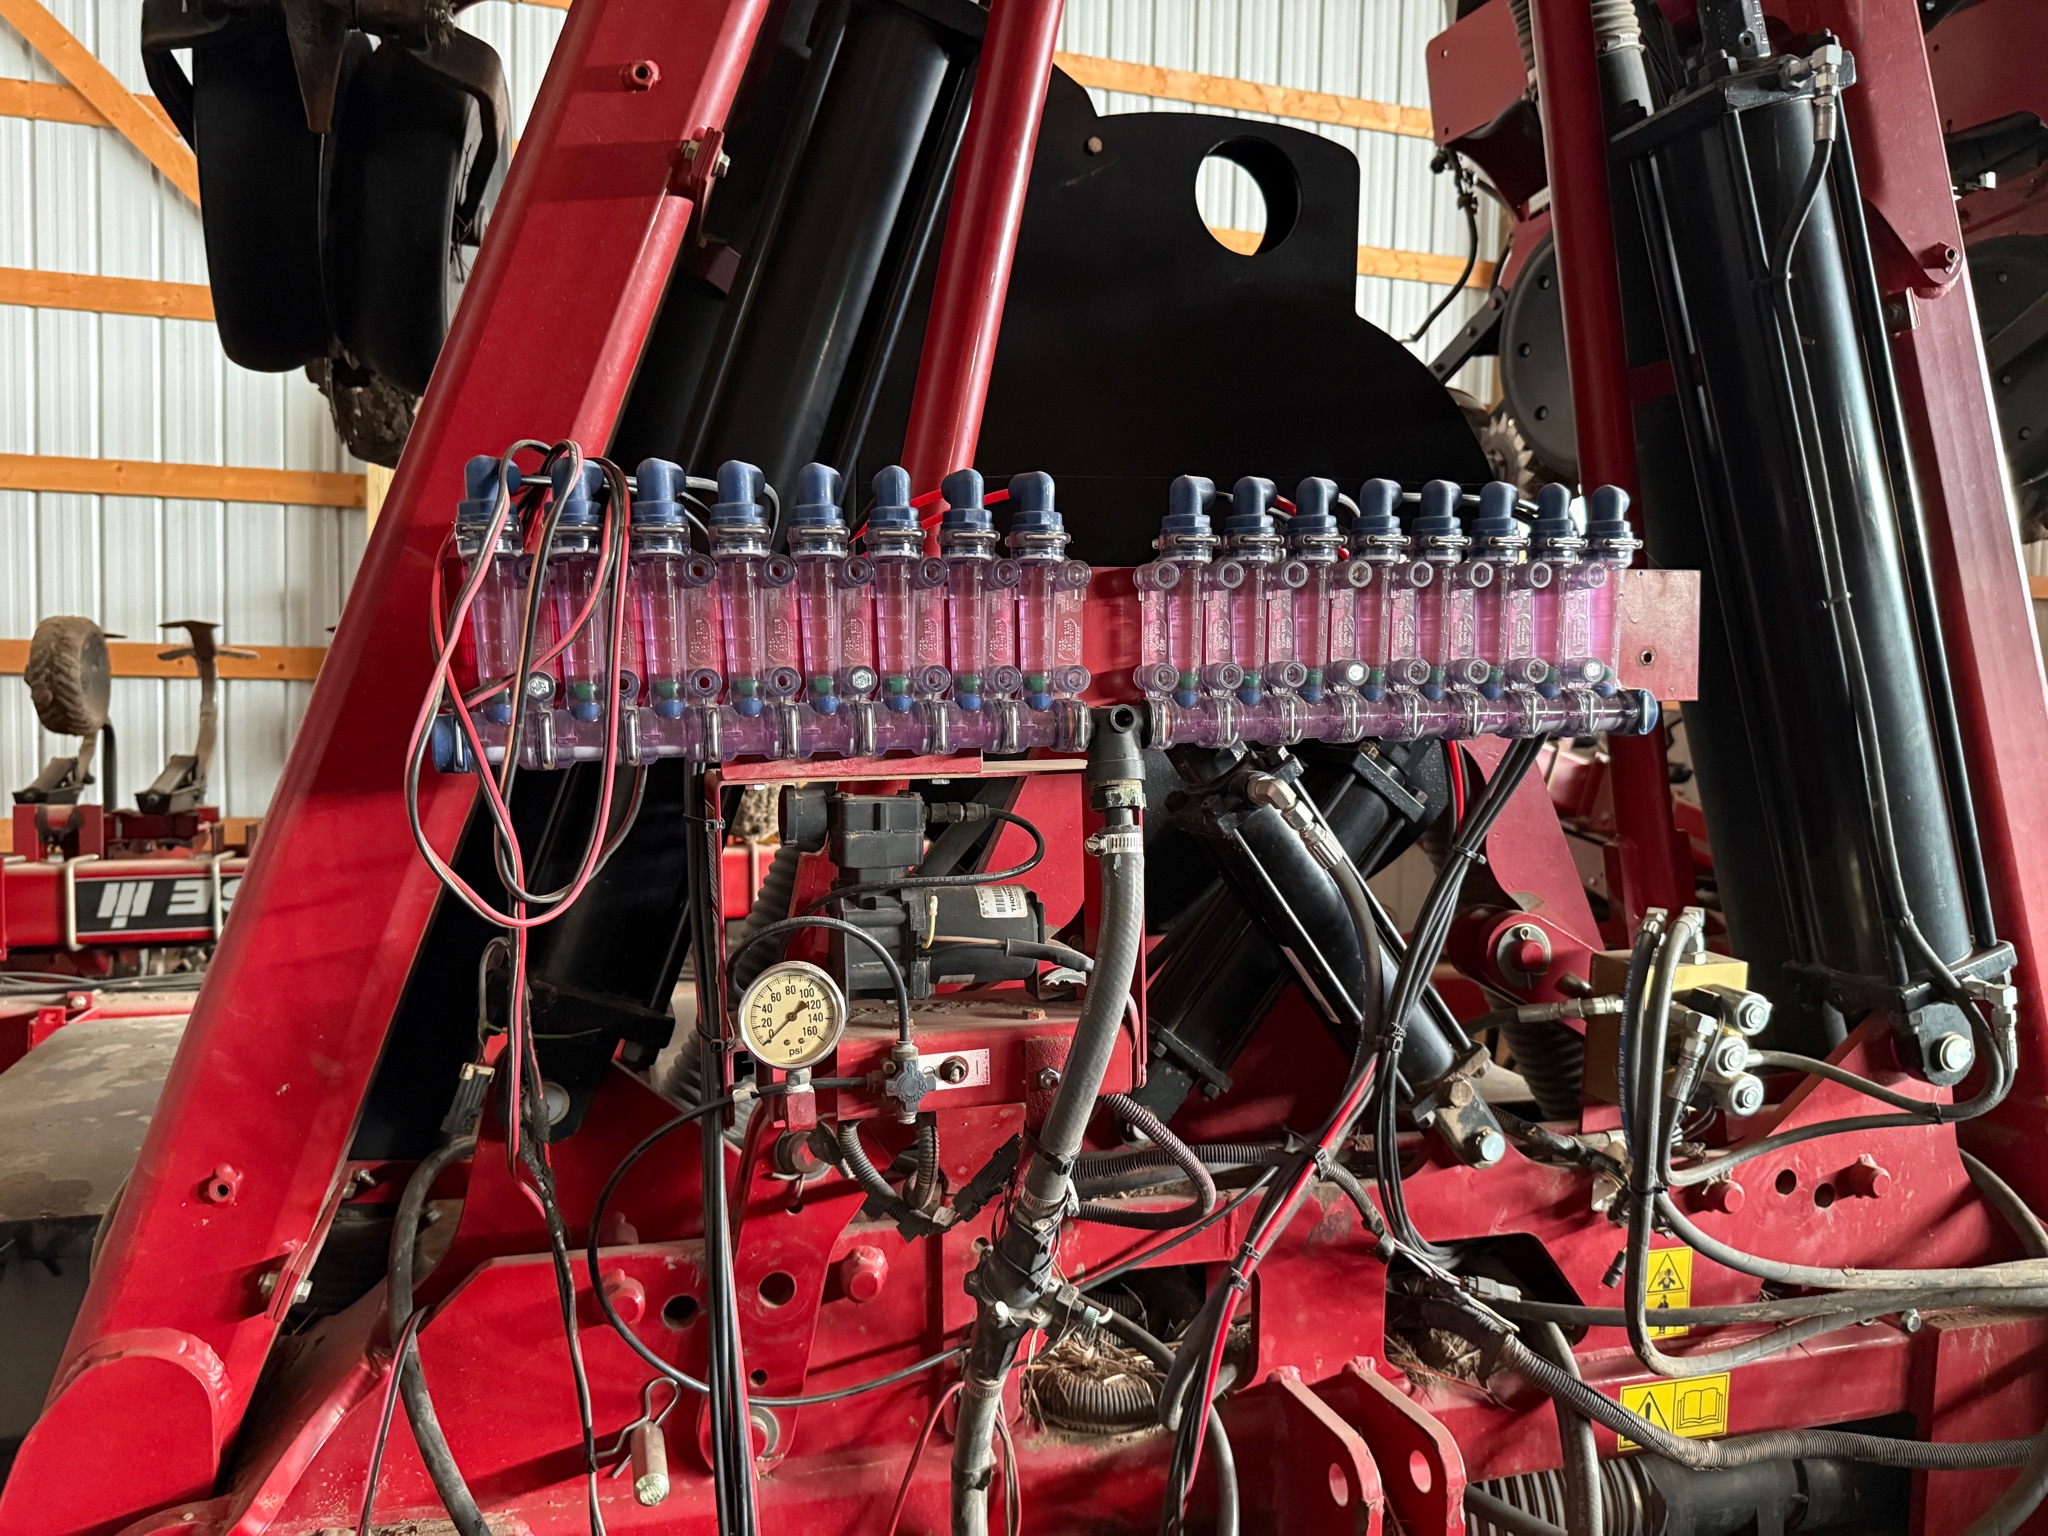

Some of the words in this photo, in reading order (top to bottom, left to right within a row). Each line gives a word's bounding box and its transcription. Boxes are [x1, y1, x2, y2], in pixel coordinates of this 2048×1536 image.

[1102, 884, 1112, 936] FRONTIER
[785, 985, 796, 996] 80
[799, 988, 815, 999] 100
[770, 992, 782, 1003] 60
[761, 1003, 773, 1014] 40
[807, 1000, 821, 1011] 120
[761, 1017, 772, 1028] 20
[808, 1012, 824, 1023] 140
[768, 1029, 774, 1039] 0
[802, 1026, 818, 1037] 160
[788, 1046, 803, 1057] psi
